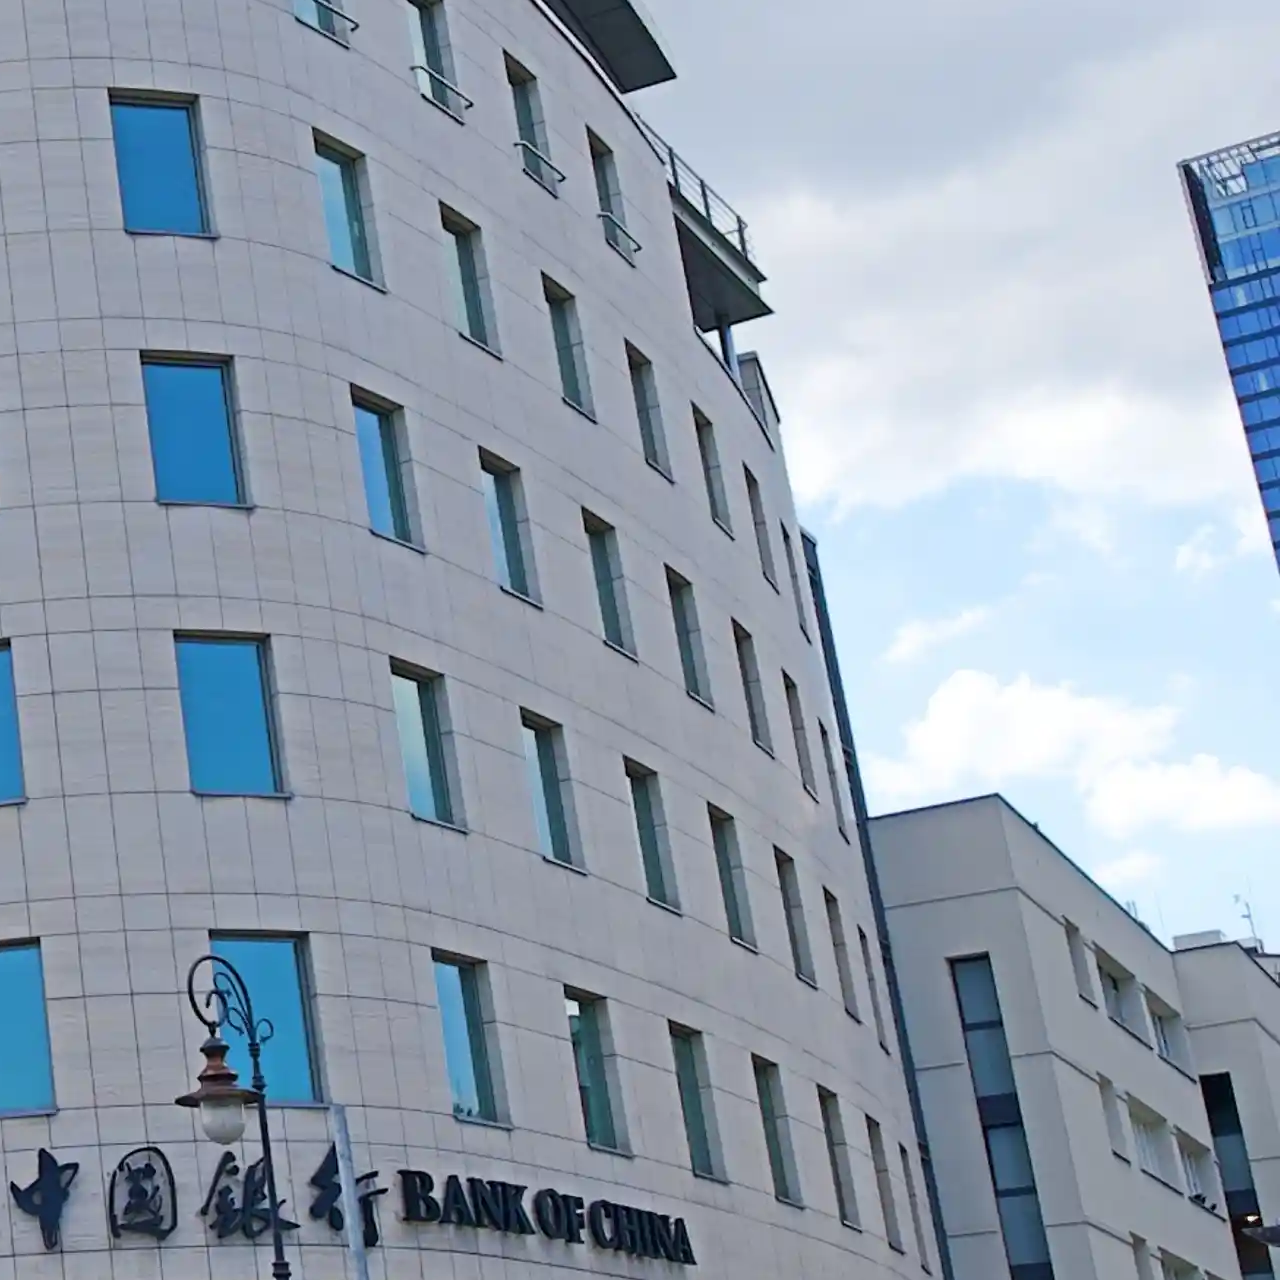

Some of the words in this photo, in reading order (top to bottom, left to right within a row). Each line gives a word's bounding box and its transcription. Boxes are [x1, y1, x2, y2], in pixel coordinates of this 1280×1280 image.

[396, 1168, 536, 1235] BANK
[534, 1187, 586, 1245] OF
[588, 1198, 698, 1266] CHINA
